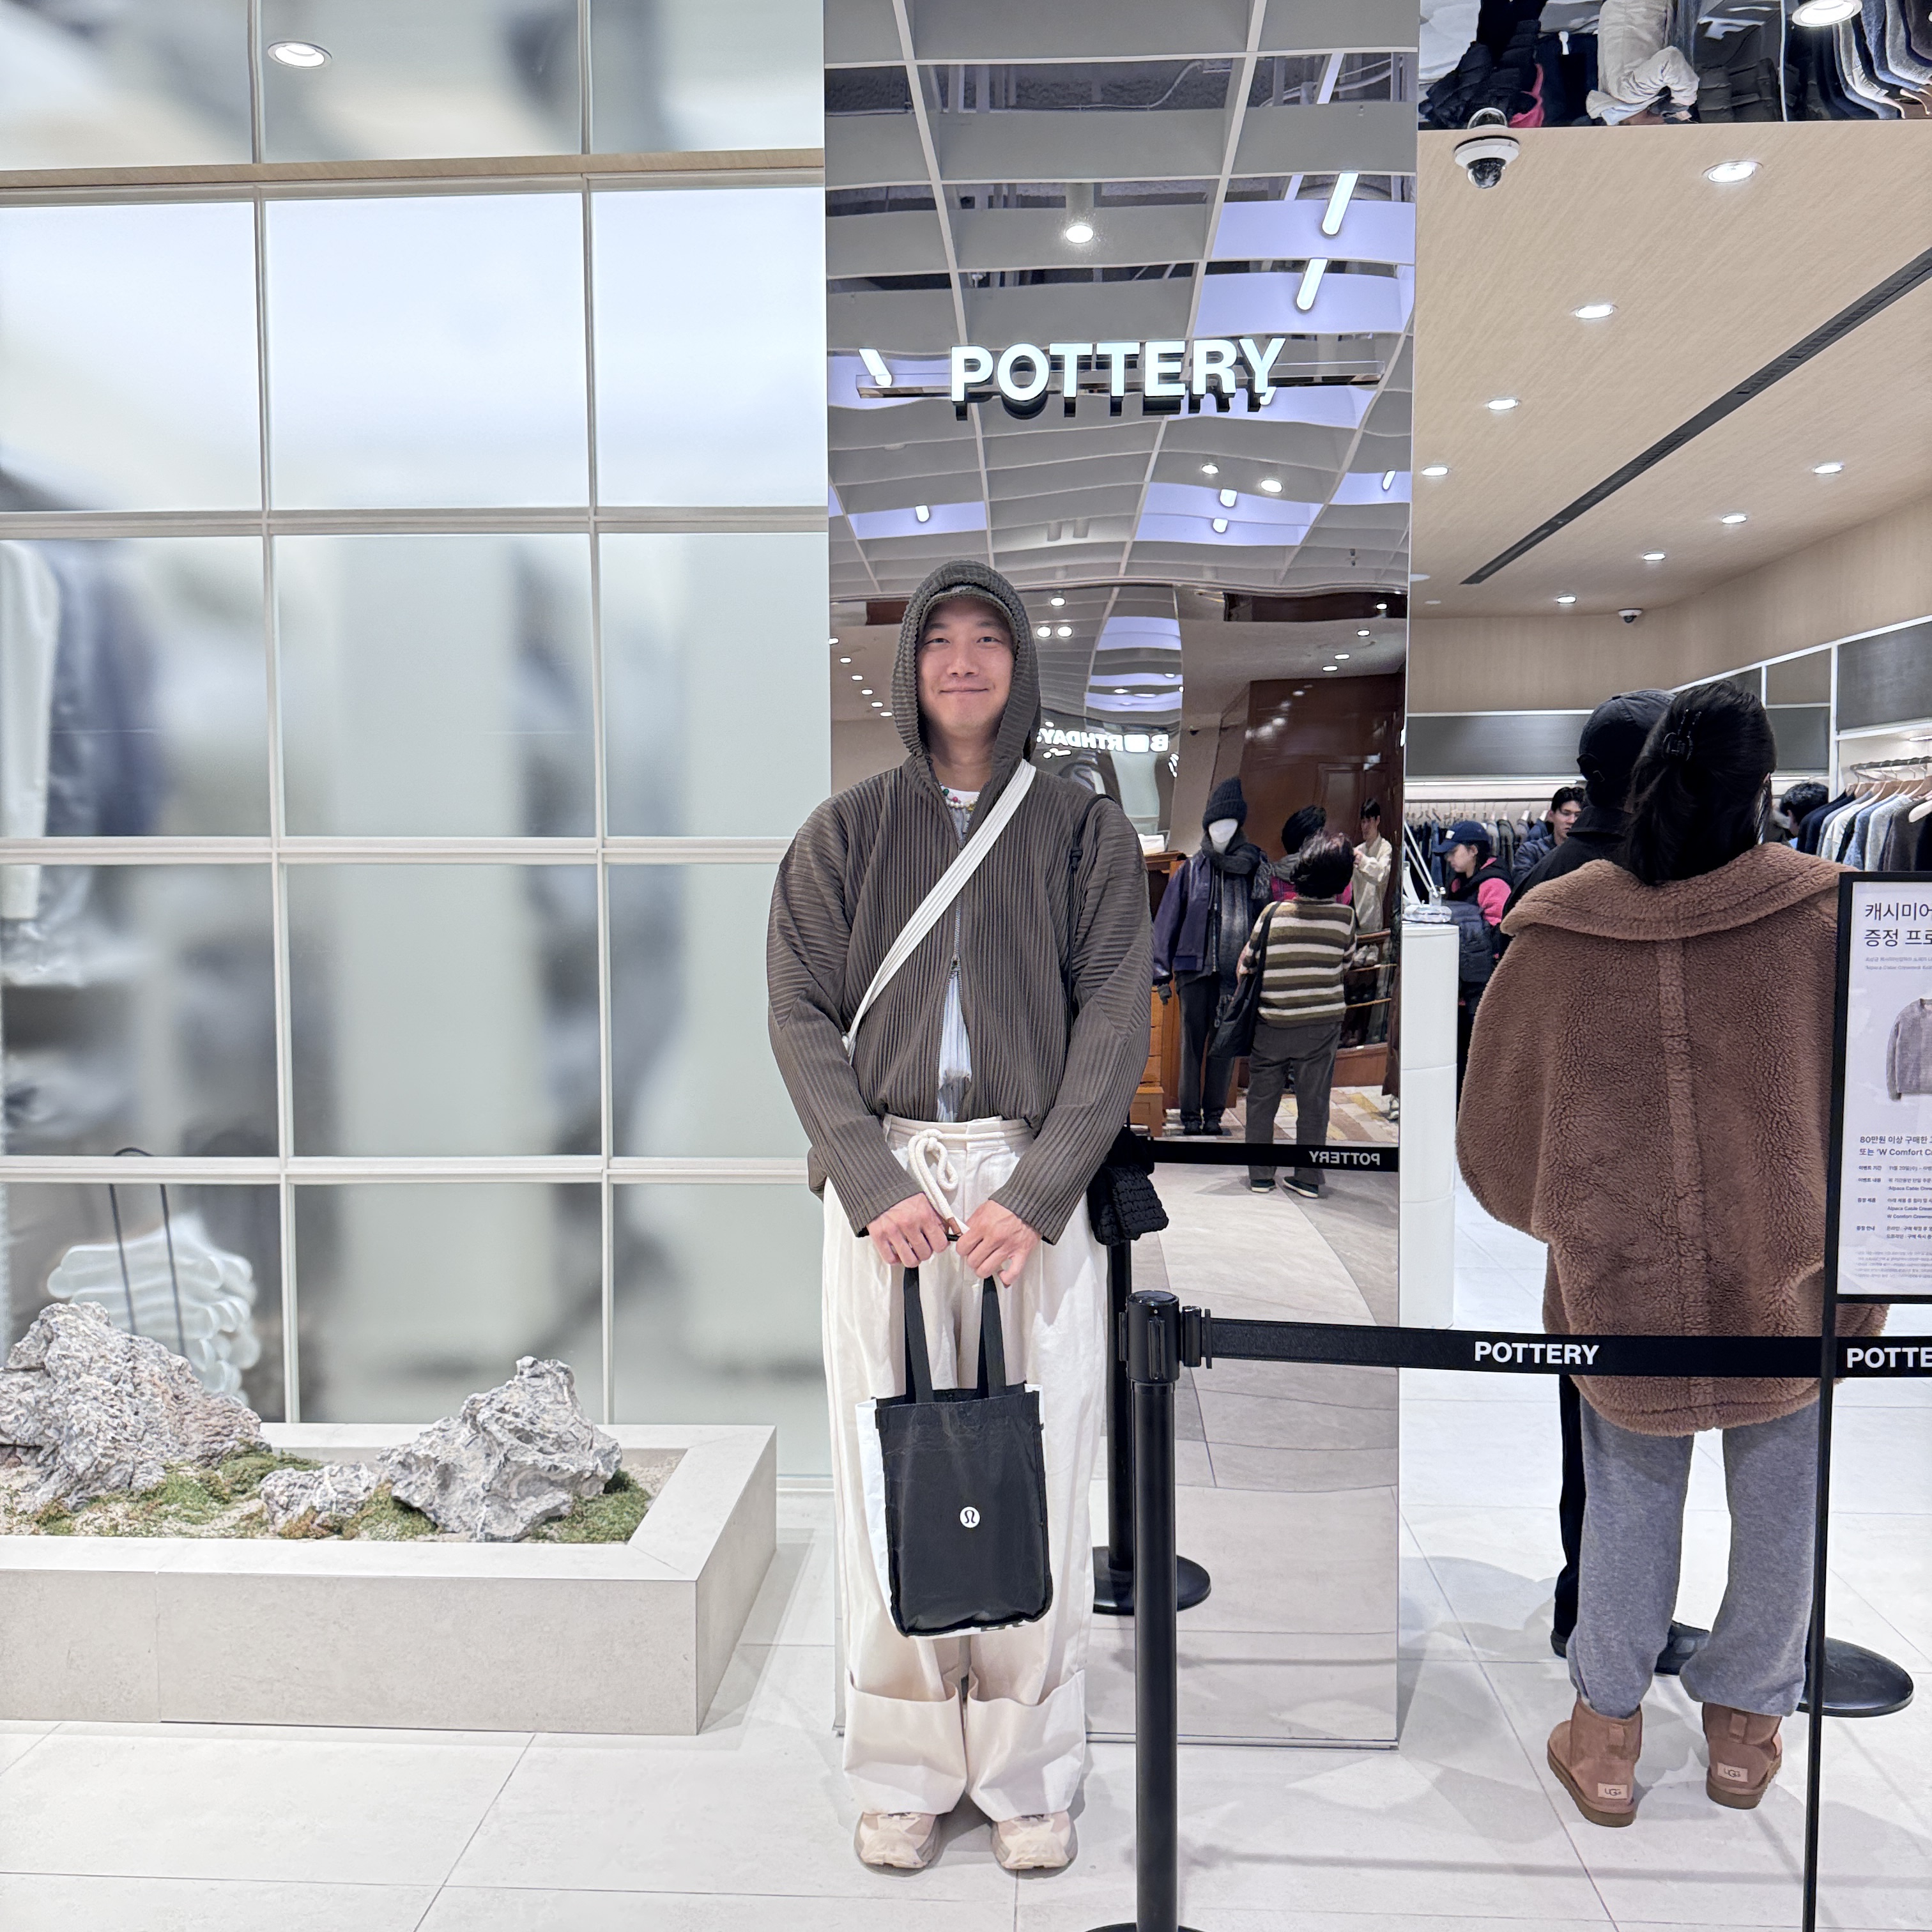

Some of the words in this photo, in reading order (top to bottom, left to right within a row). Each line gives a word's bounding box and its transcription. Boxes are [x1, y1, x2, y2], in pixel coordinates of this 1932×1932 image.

[950, 338, 1287, 403] POTTERY
[1865, 902, 1932, 921] 캐시미어
[1864, 928, 1898, 947] 증정
[1860, 1136, 1886, 1144] 80만원
[1888, 1136, 1903, 1144] 이상
[1905, 1136, 1928, 1144] 구매한
[1474, 1340, 1600, 1365] POTTERY
[1846, 1347, 1932, 1368] POTTE
[1604, 1788, 1621, 1796] UGG
